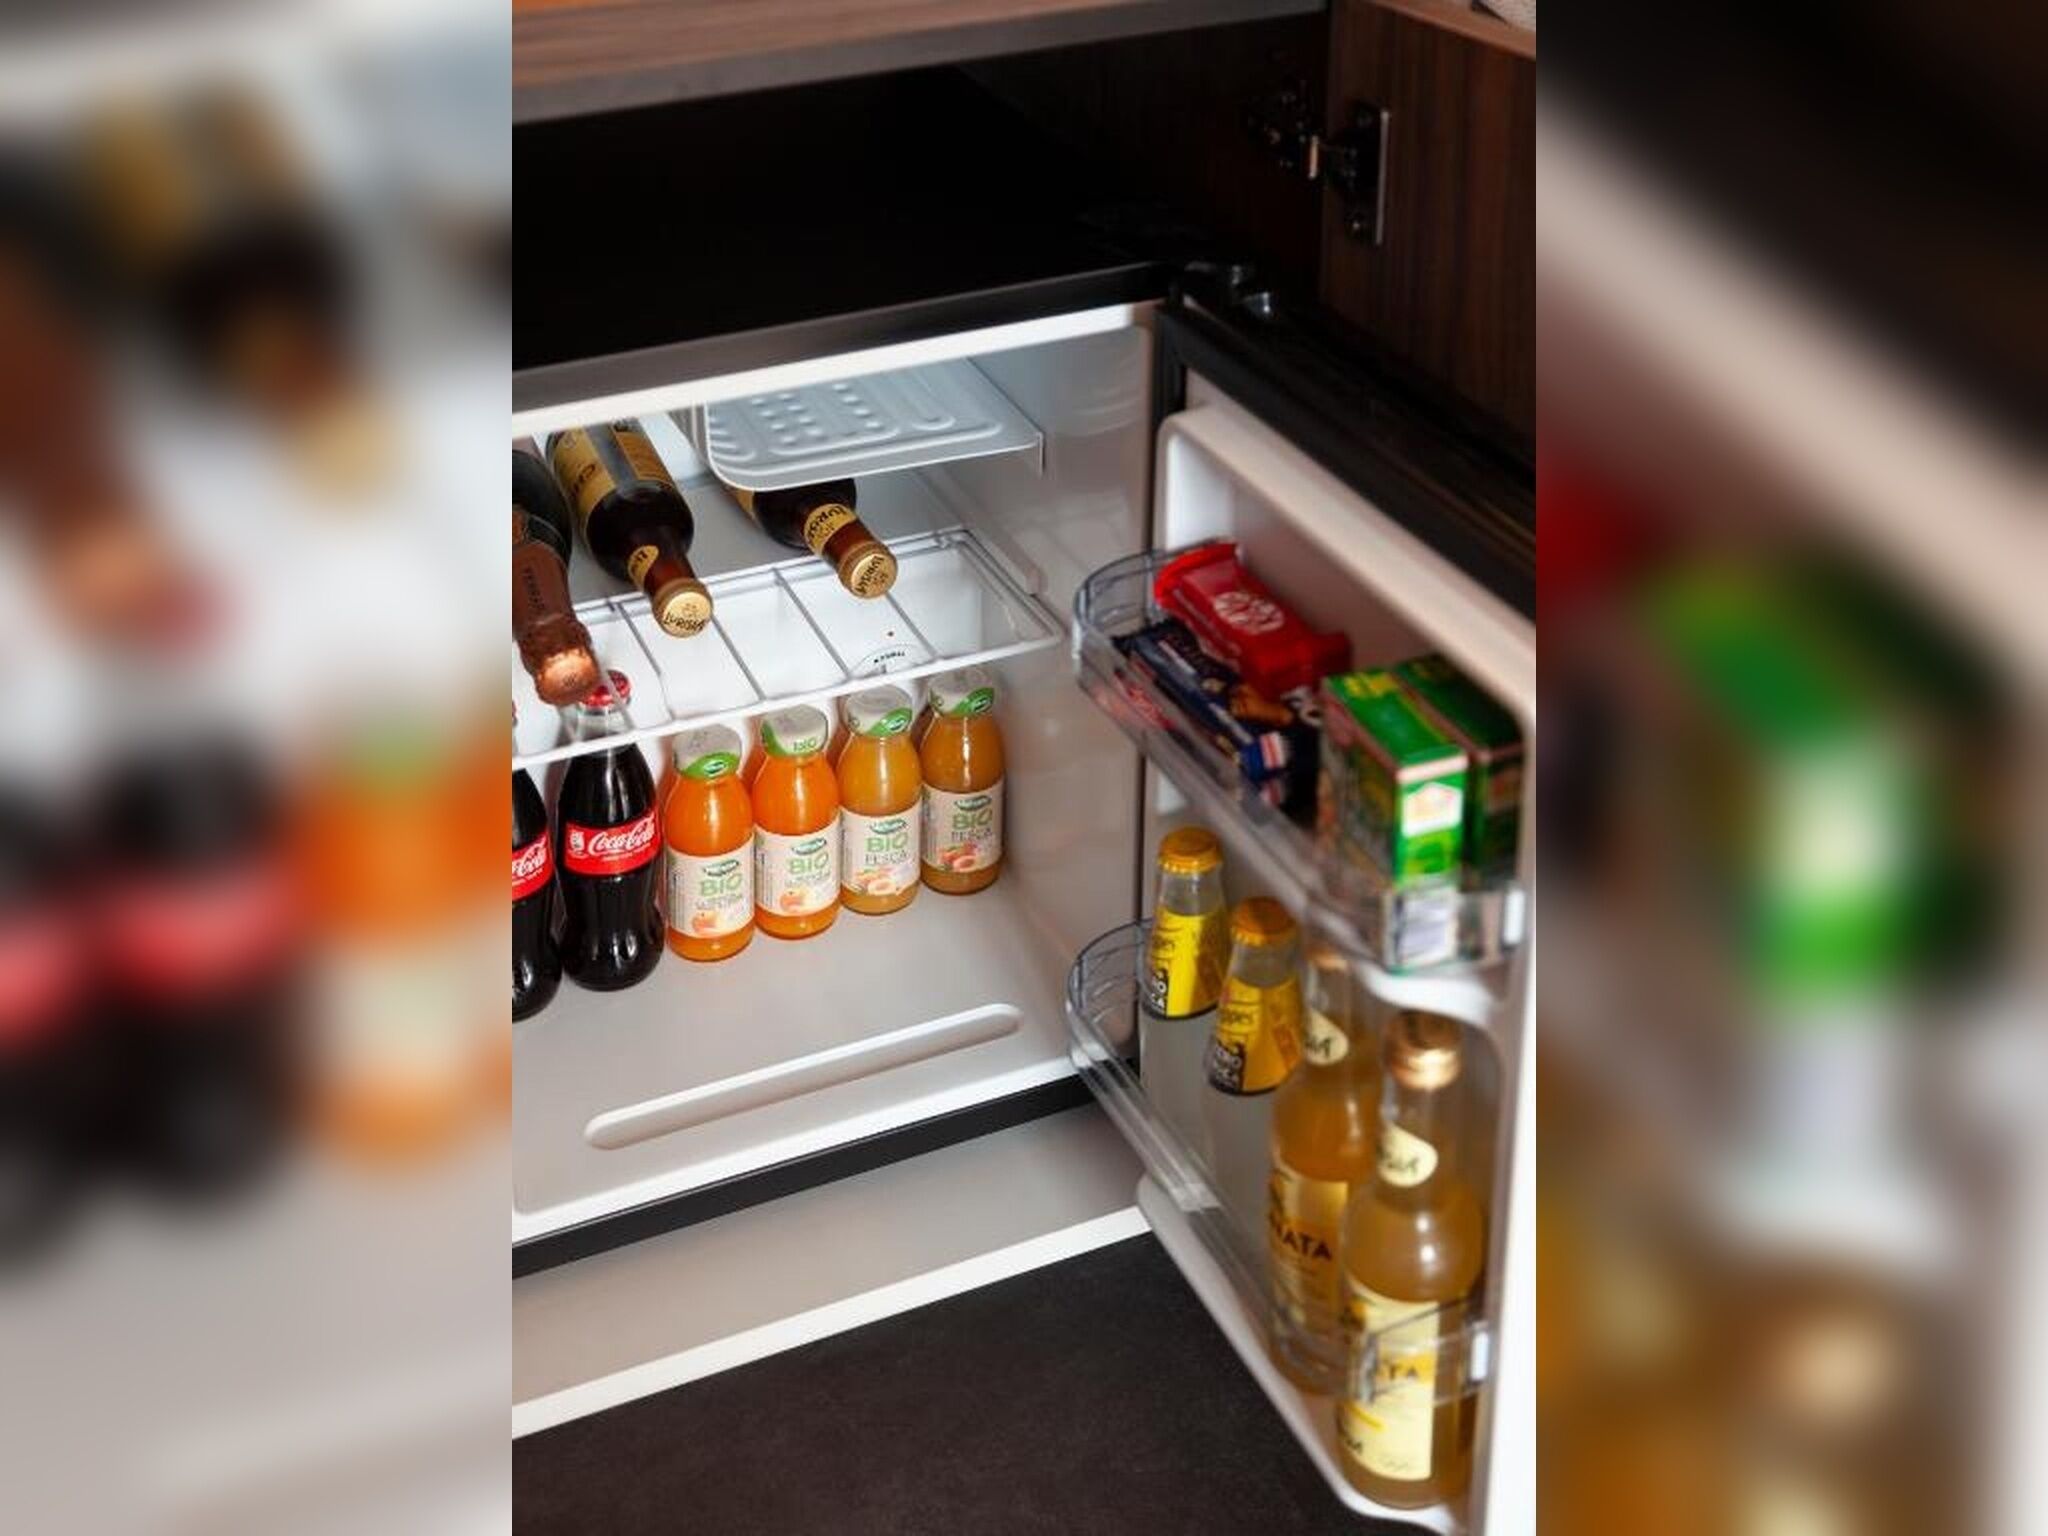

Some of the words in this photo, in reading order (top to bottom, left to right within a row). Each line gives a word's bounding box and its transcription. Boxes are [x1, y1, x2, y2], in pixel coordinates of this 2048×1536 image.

[955, 806, 993, 830] BIO
[587, 811, 655, 857] Coca-Cola
[866, 831, 909, 852] BIO
[789, 851, 829, 875] BIO
[700, 873, 742, 896] BIO
